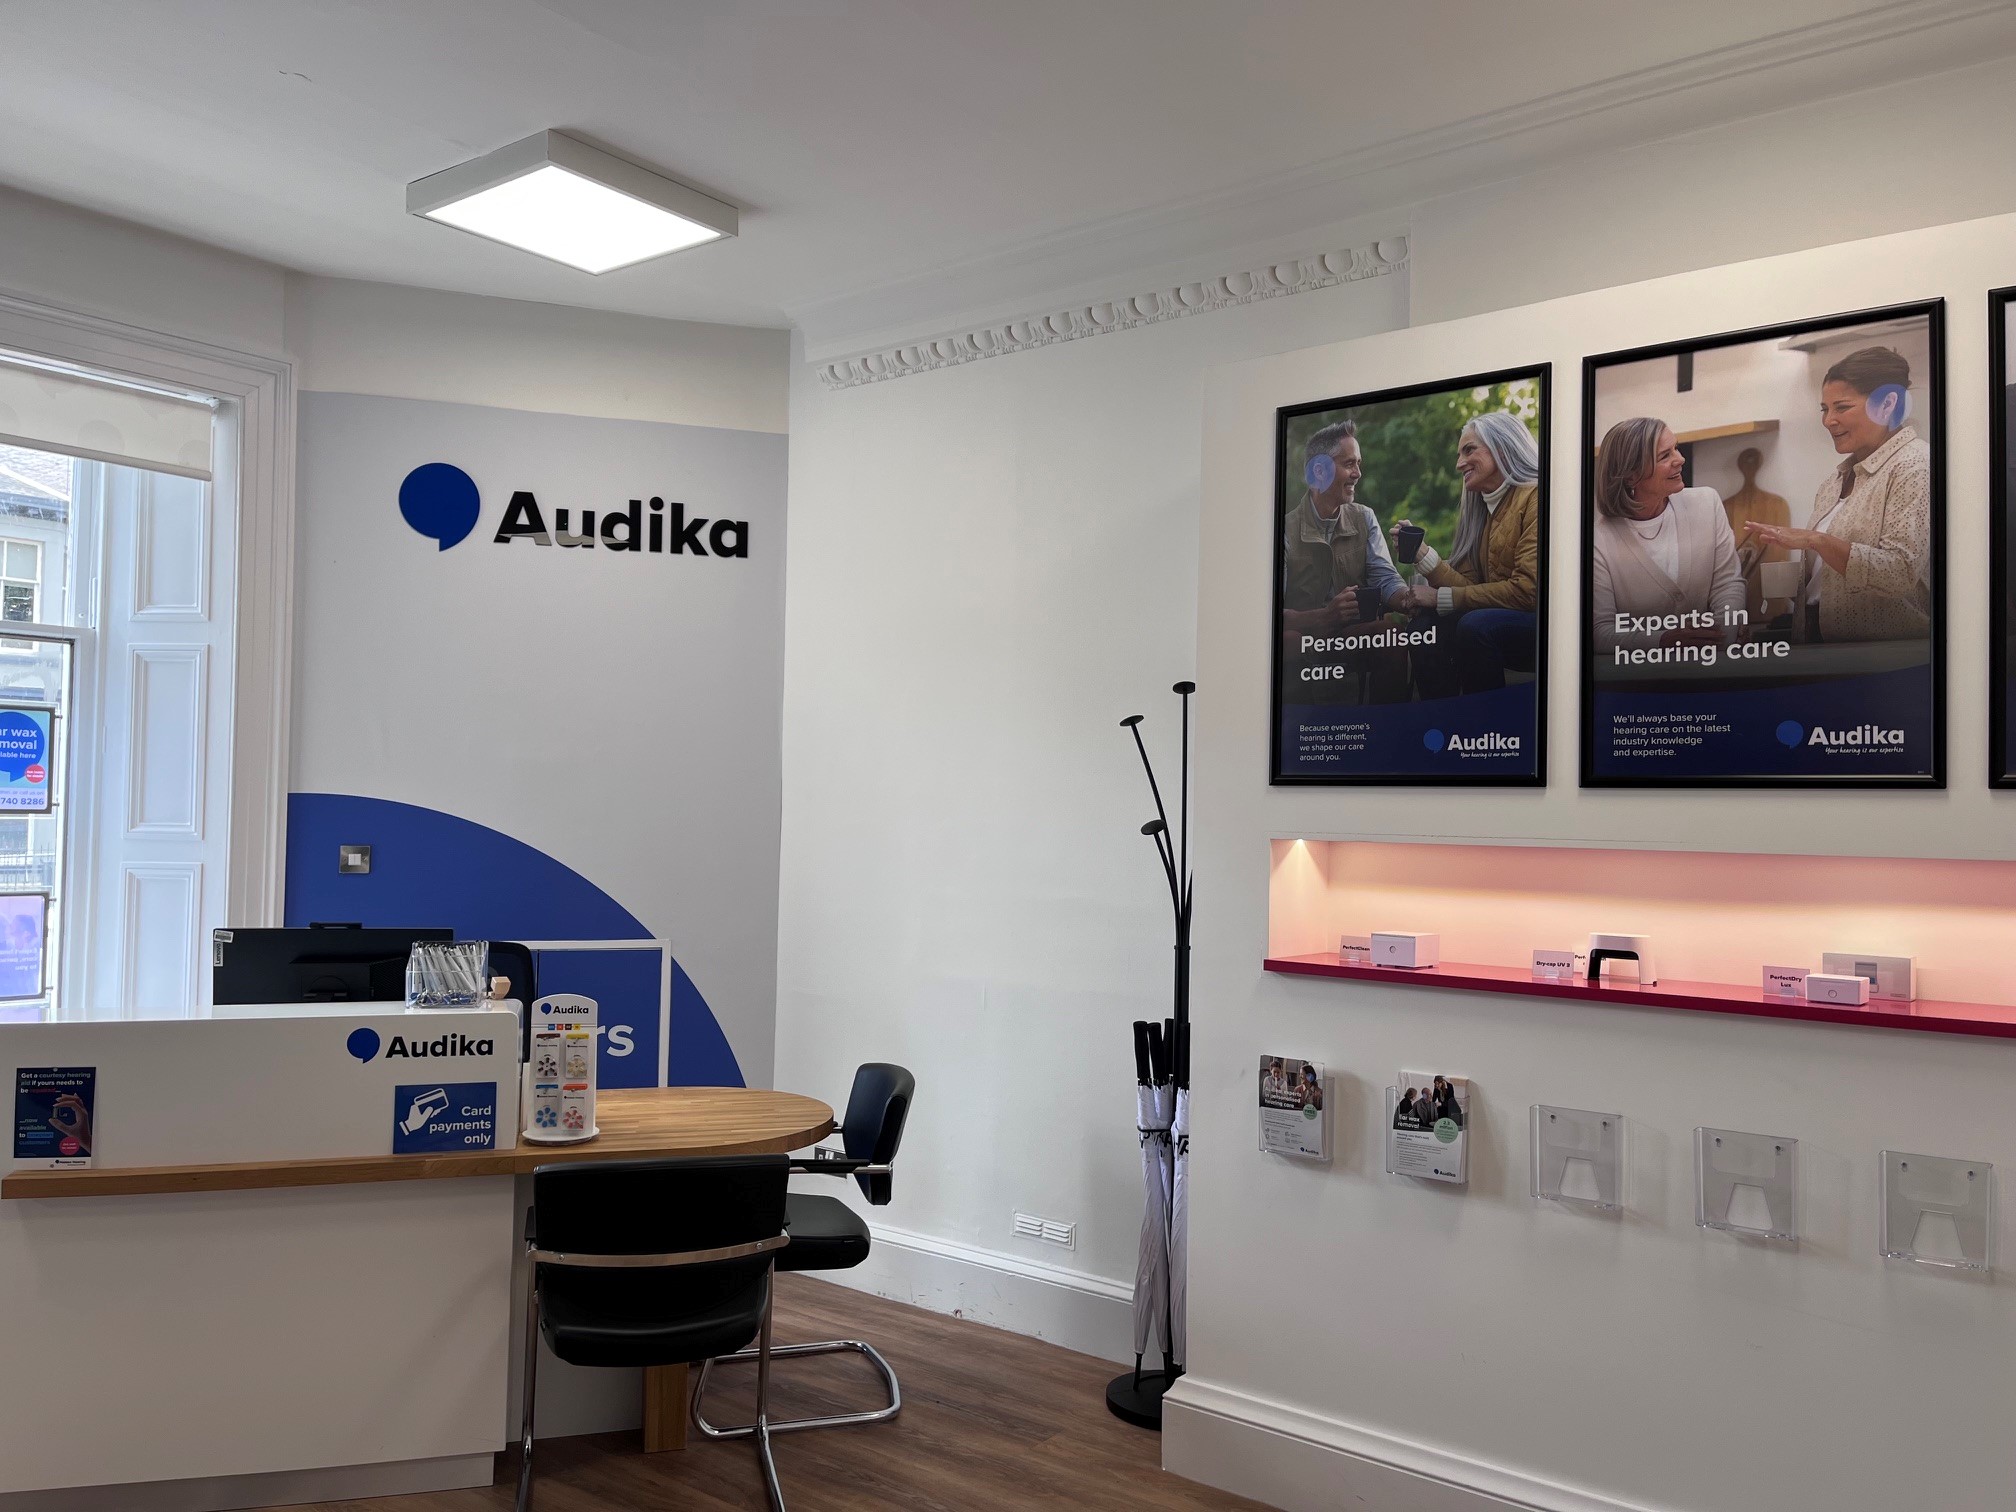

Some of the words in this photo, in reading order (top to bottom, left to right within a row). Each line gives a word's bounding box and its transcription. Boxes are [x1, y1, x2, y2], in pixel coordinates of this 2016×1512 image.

[493, 490, 749, 559] Audika
[1615, 609, 1715, 636] Experts
[1724, 605, 1748, 626] in
[1300, 626, 1437, 653] Personalised
[1614, 641, 1717, 666] hearing
[1726, 640, 1791, 659] care
[1300, 664, 1345, 681] care
[1613, 715, 1635, 723] We'll
[1636, 715, 1668, 724] always
[1670, 714, 1693, 722] base
[1695, 714, 1717, 723] your
[11, 729, 37, 737] wax
[1331, 723, 1370, 732] everyone's
[1613, 726, 1647, 735] hearing
[1649, 726, 1670, 734] care
[1672, 726, 1684, 734] on
[1686, 724, 1702, 733] the
[1704, 724, 1731, 732] latest
[1335, 733, 1367, 741] different,
[1808, 724, 1904, 745] Audika
[1447, 732, 1520, 750] Audika
[1613, 737, 1649, 746] industry
[1651, 736, 1703, 746] knowledge
[1311, 744, 1333, 752] shape
[1613, 748, 1630, 756] and
[1632, 748, 1677, 757] expertise.
[1840, 746, 1860, 755] hearing
[1879, 746, 1904, 754] expertise
[20, 797, 44, 805] 8286
[1770, 974, 1802, 982] PerfectDry
[553, 1005, 589, 1014] Audika
[385, 1033, 494, 1059] Audika
[461, 1105, 491, 1116] Card
[429, 1120, 491, 1134] payments
[464, 1133, 491, 1145] only
